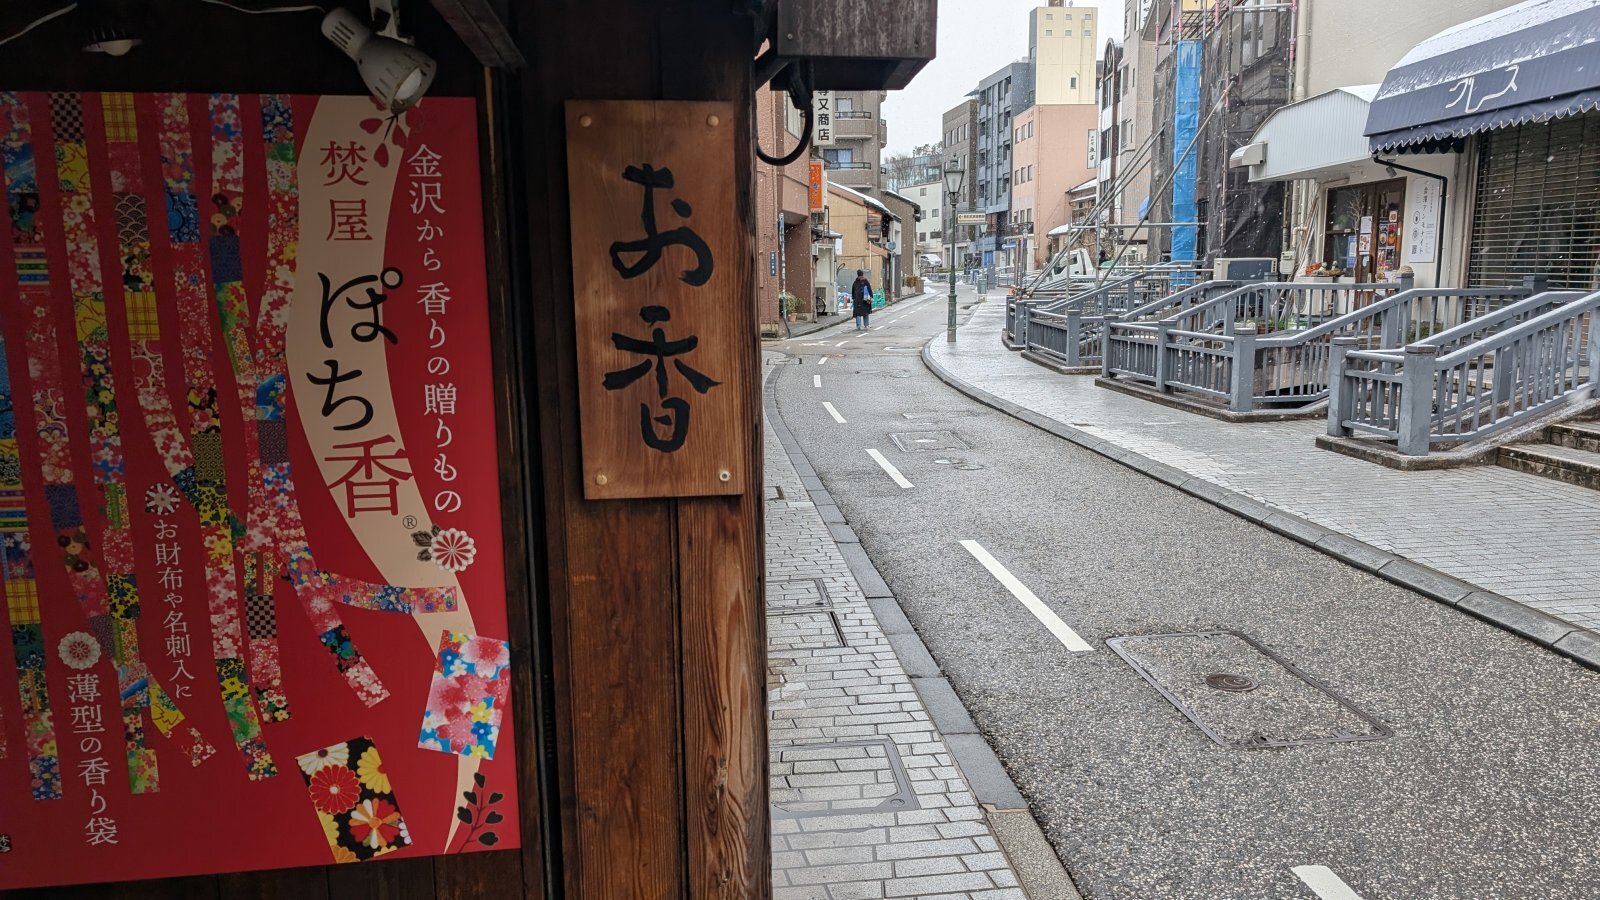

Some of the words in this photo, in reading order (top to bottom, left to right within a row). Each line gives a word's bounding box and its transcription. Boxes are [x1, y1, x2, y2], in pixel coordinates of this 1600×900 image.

[319, 140, 373, 241] 焚屋
[306, 266, 414, 519] ぽち香
[406, 143, 462, 513] 金沢から香りの贈りもの
[601, 162, 724, 454] お香
[153, 518, 195, 699] お財布や名刺入に
[66, 673, 119, 847] 薄型の香り袋
